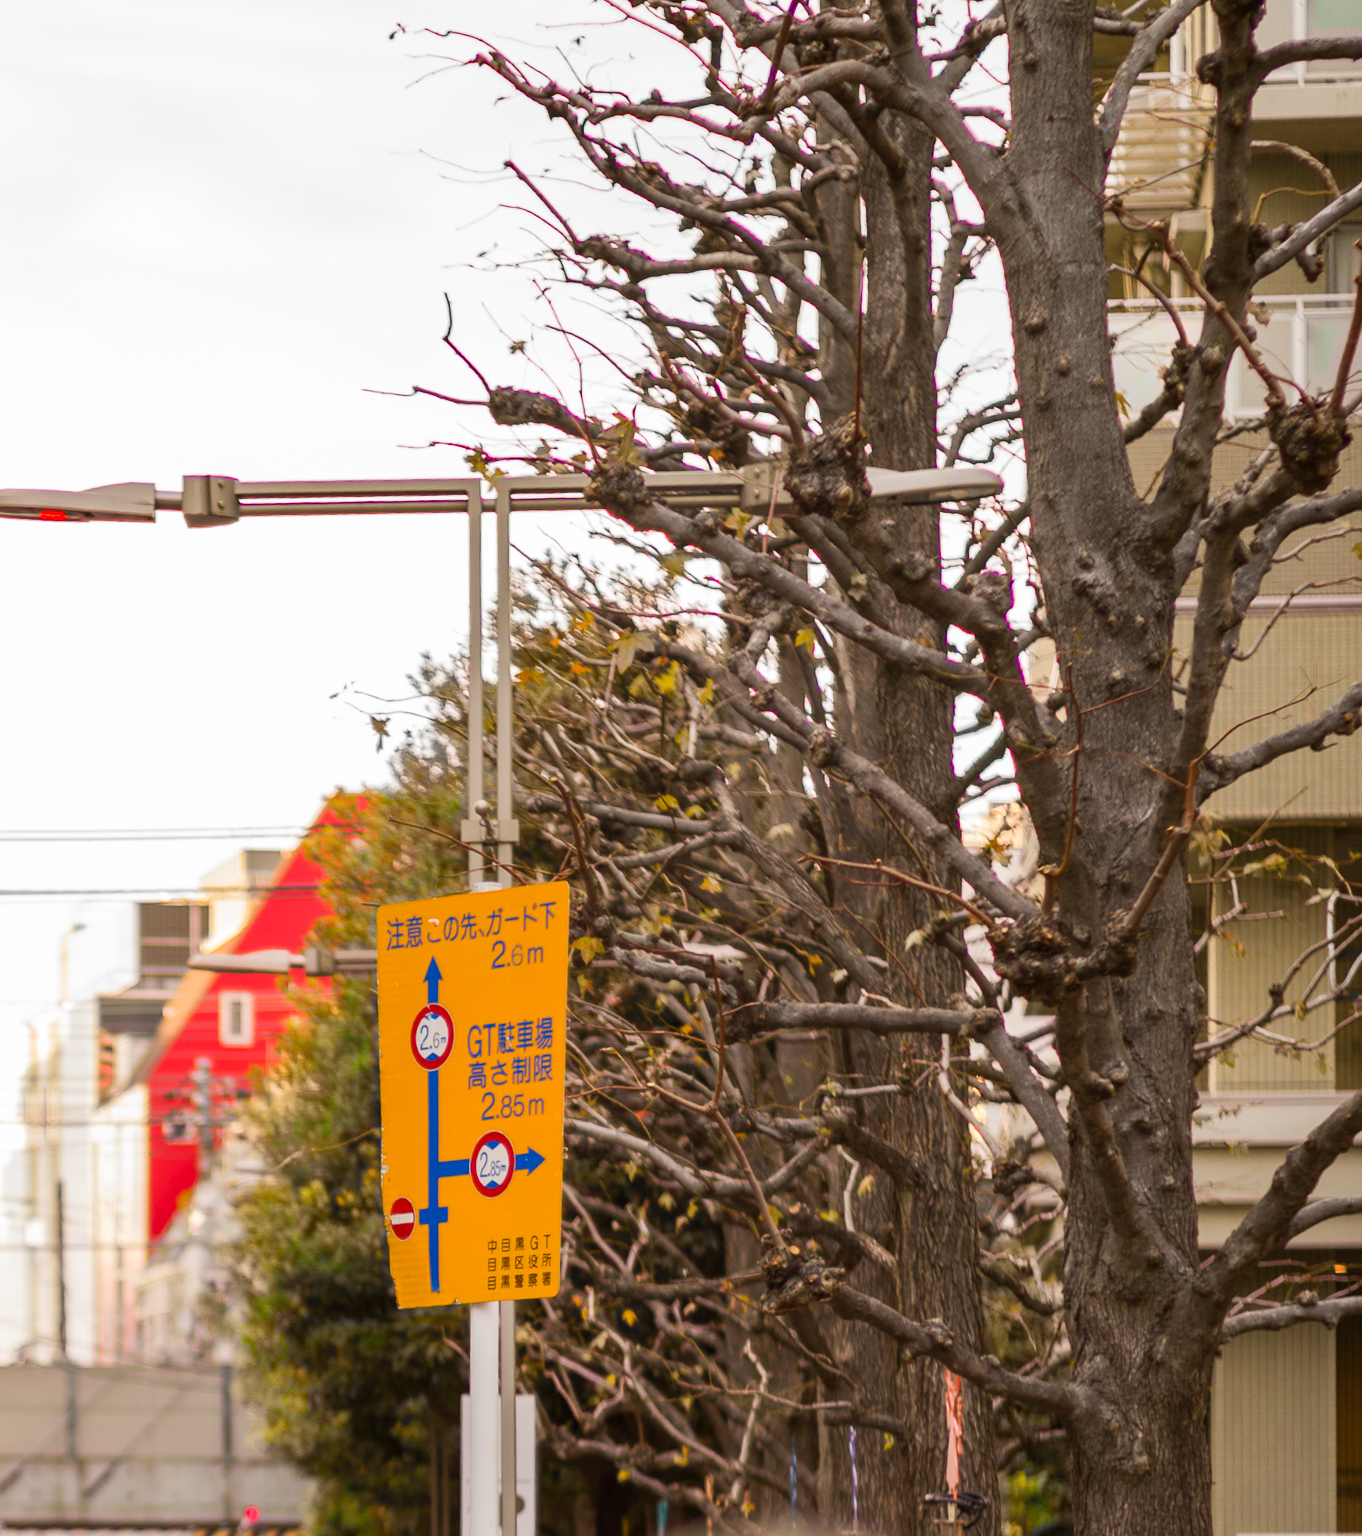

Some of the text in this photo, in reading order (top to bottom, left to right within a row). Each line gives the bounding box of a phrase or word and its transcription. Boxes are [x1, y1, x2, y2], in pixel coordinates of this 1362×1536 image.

[491, 940, 544, 969] 2.6m
[467, 1017, 554, 1058] GT駐車場
[468, 1053, 553, 1090] 高さ制限
[481, 1092, 545, 1121] 2.85m
[479, 1152, 507, 1178] 2.85m
[487, 1253, 551, 1271] 目黒区役所
